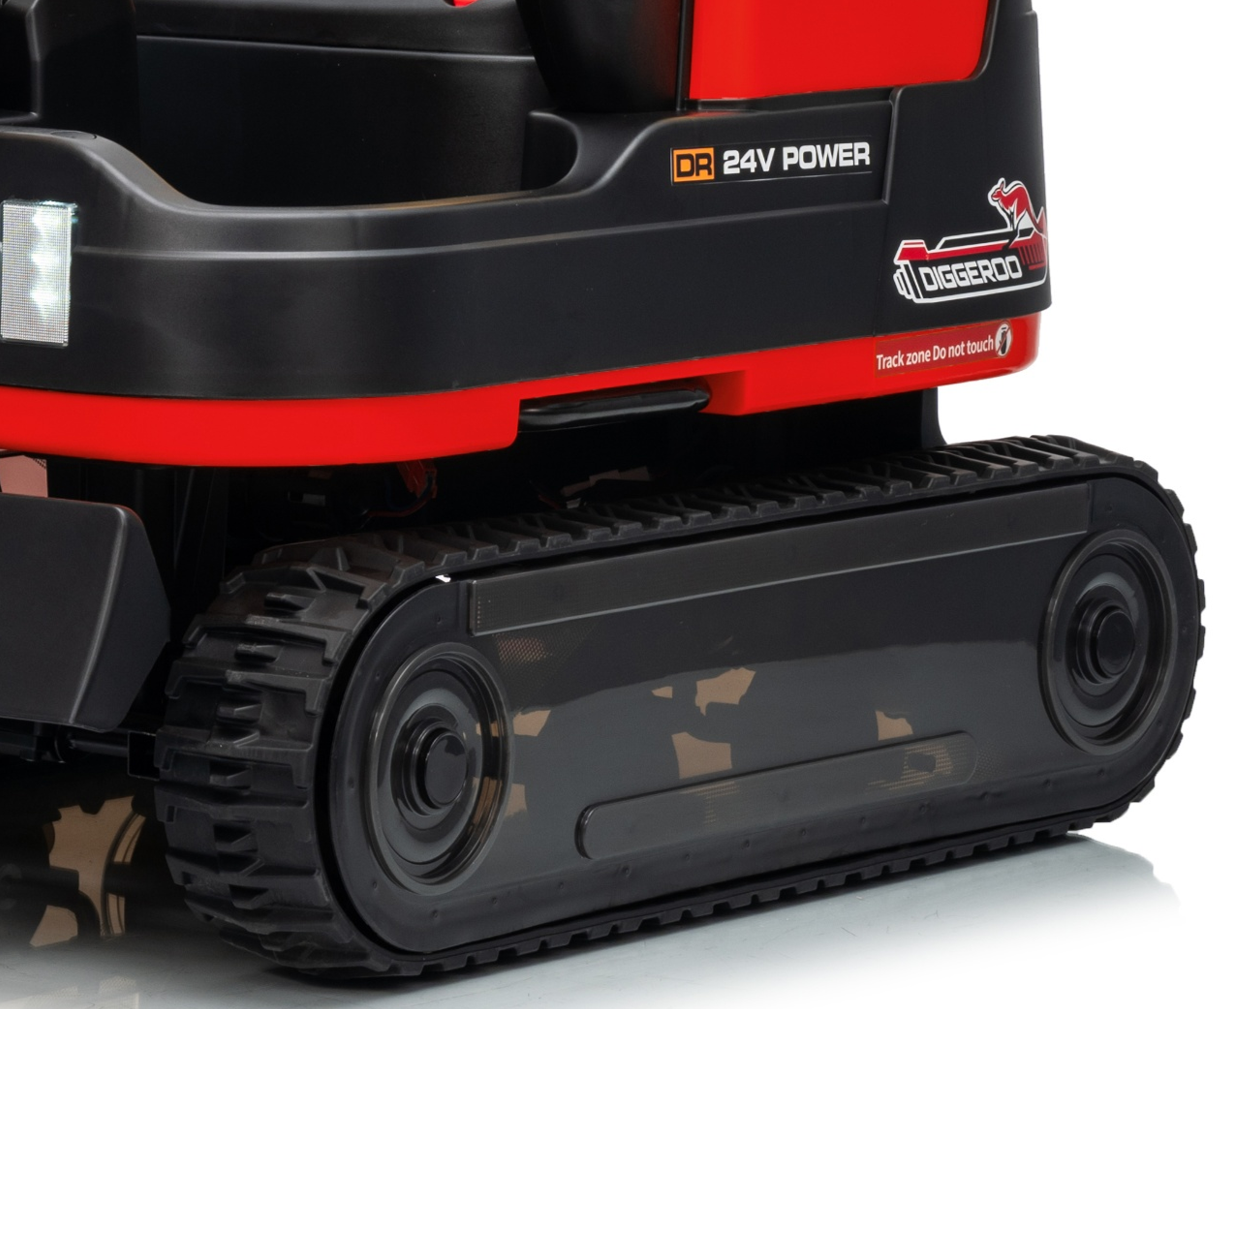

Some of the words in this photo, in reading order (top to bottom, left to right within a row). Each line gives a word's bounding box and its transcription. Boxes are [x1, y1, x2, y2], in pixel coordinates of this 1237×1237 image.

[676, 152, 713, 178] DR
[723, 147, 776, 175] 24V
[782, 141, 871, 171] POWER
[918, 255, 1023, 292] DIGGEROO
[876, 350, 905, 370] Track
[906, 349, 931, 365] zone
[933, 345, 946, 361] Do
[948, 341, 965, 358] not
[967, 335, 994, 354] touch
